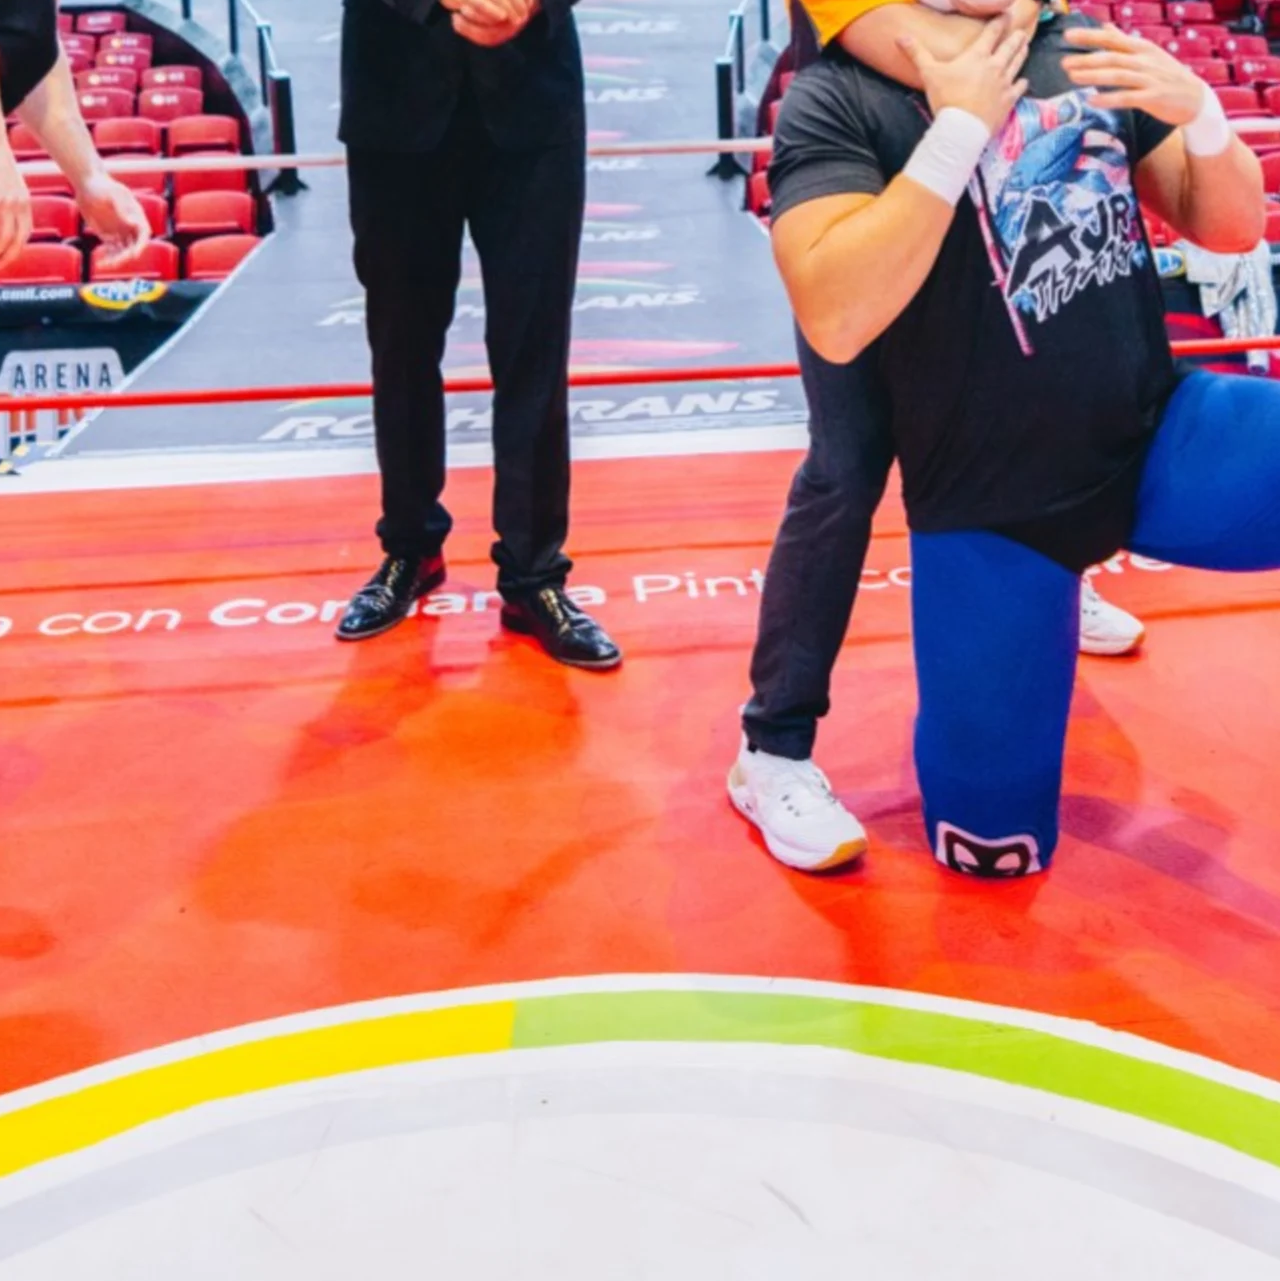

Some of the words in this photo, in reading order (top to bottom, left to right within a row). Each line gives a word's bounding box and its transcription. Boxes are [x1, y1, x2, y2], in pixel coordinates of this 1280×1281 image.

[13, 363, 112, 390] ARENA
[38, 606, 183, 637] con
[631, 567, 768, 603] Pint
